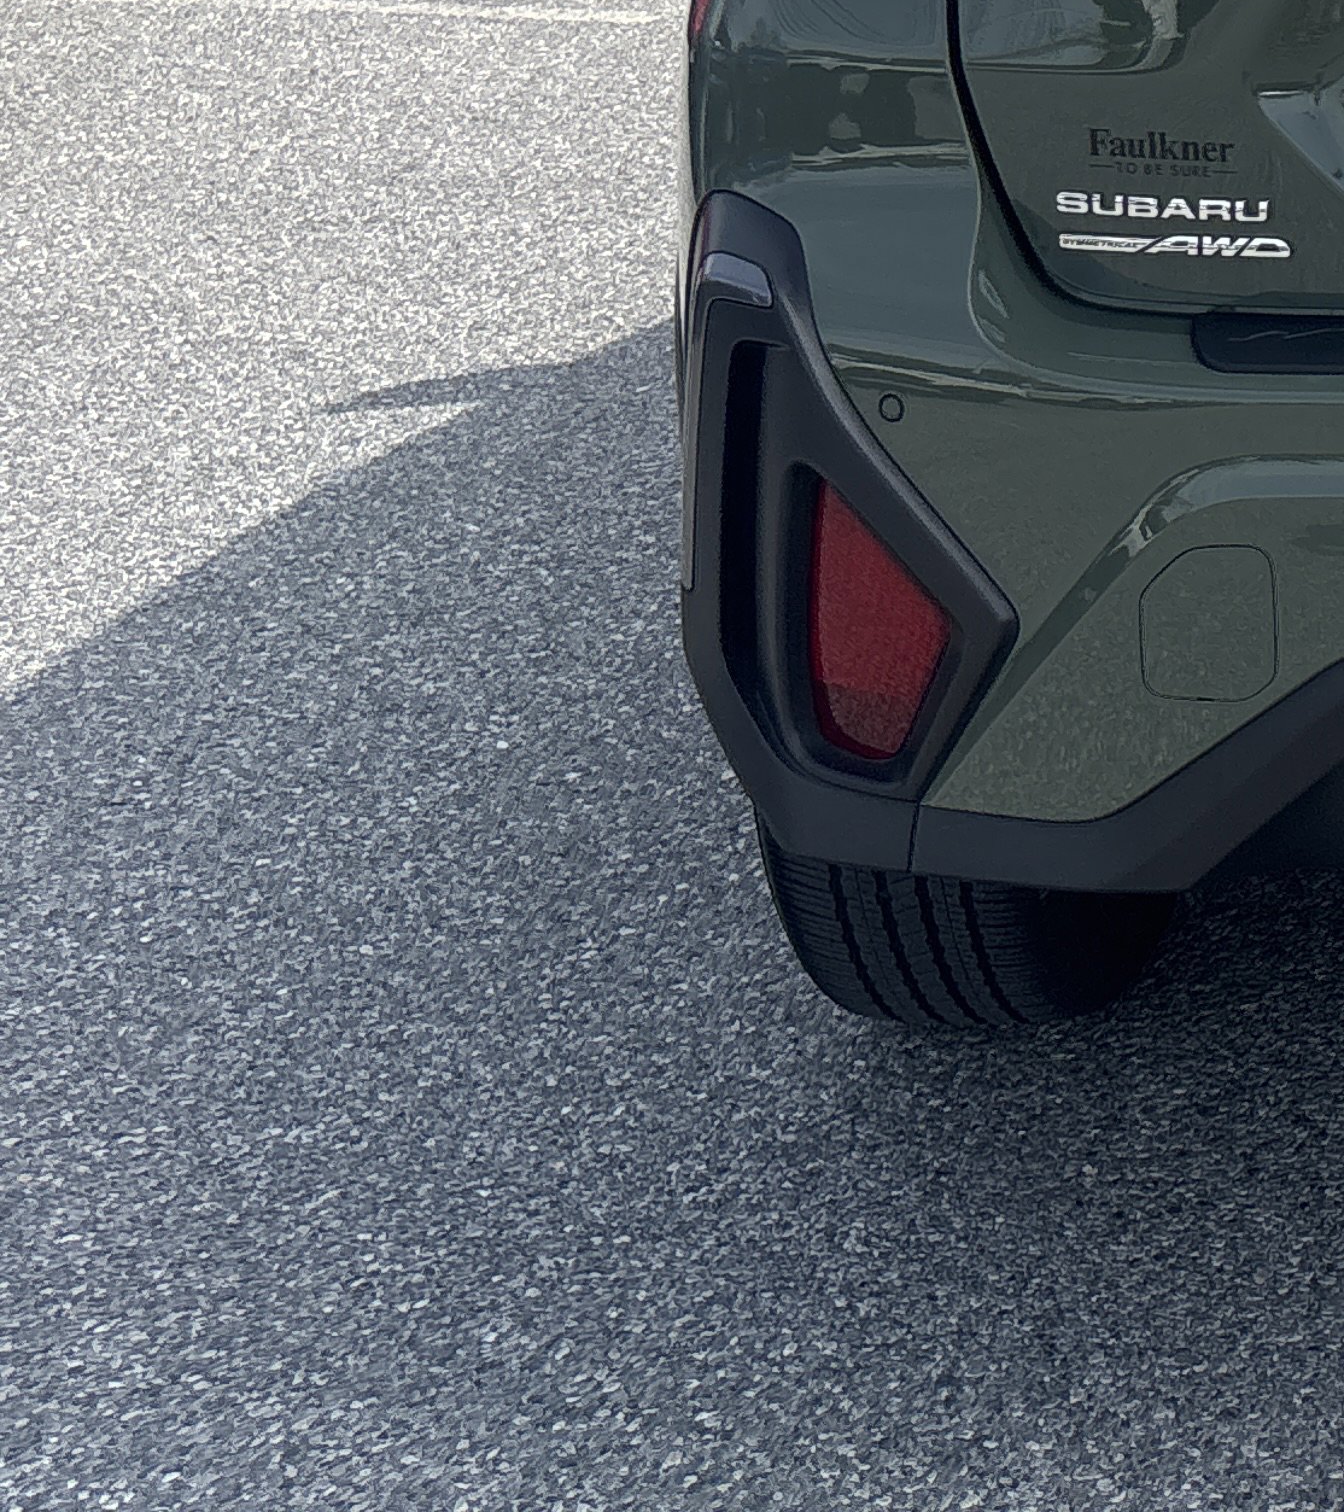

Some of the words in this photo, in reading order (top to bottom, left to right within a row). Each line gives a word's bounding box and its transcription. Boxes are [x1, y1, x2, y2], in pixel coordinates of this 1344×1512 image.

[1088, 127, 1235, 163] Faulkner
[1113, 162, 1138, 175] TO
[1169, 165, 1213, 178] SURE
[1056, 191, 1270, 222] SUBARU
[1143, 235, 1291, 258] AWD
